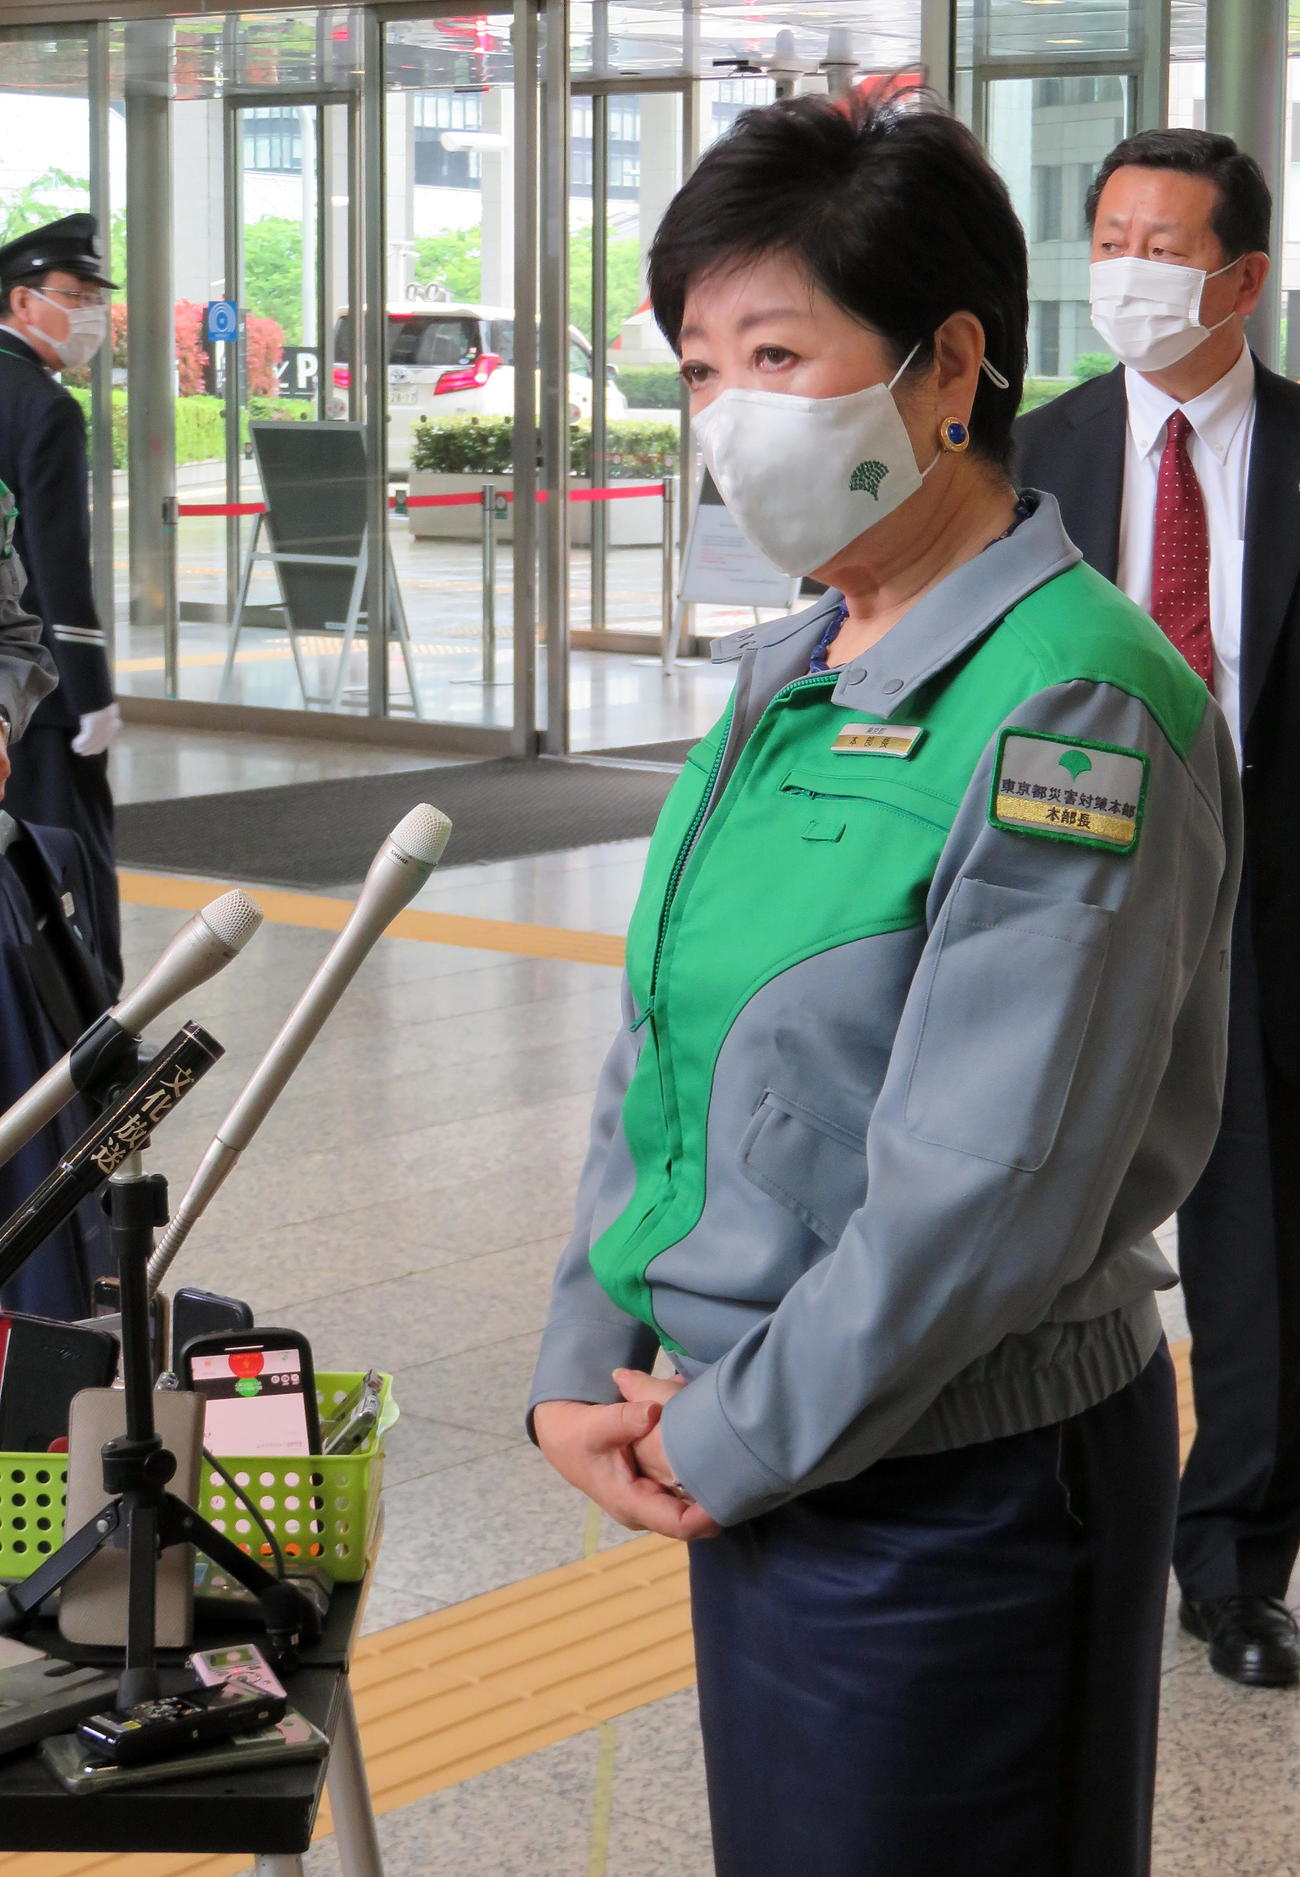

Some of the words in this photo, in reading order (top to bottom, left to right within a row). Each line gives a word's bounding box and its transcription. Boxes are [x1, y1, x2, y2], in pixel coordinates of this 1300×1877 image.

[296, 353, 319, 389] P
[1000, 778, 1136, 818] 東京都災害対策本部
[1045, 806, 1091, 829] 本部長
[90, 1064, 196, 1174] 文化放送
